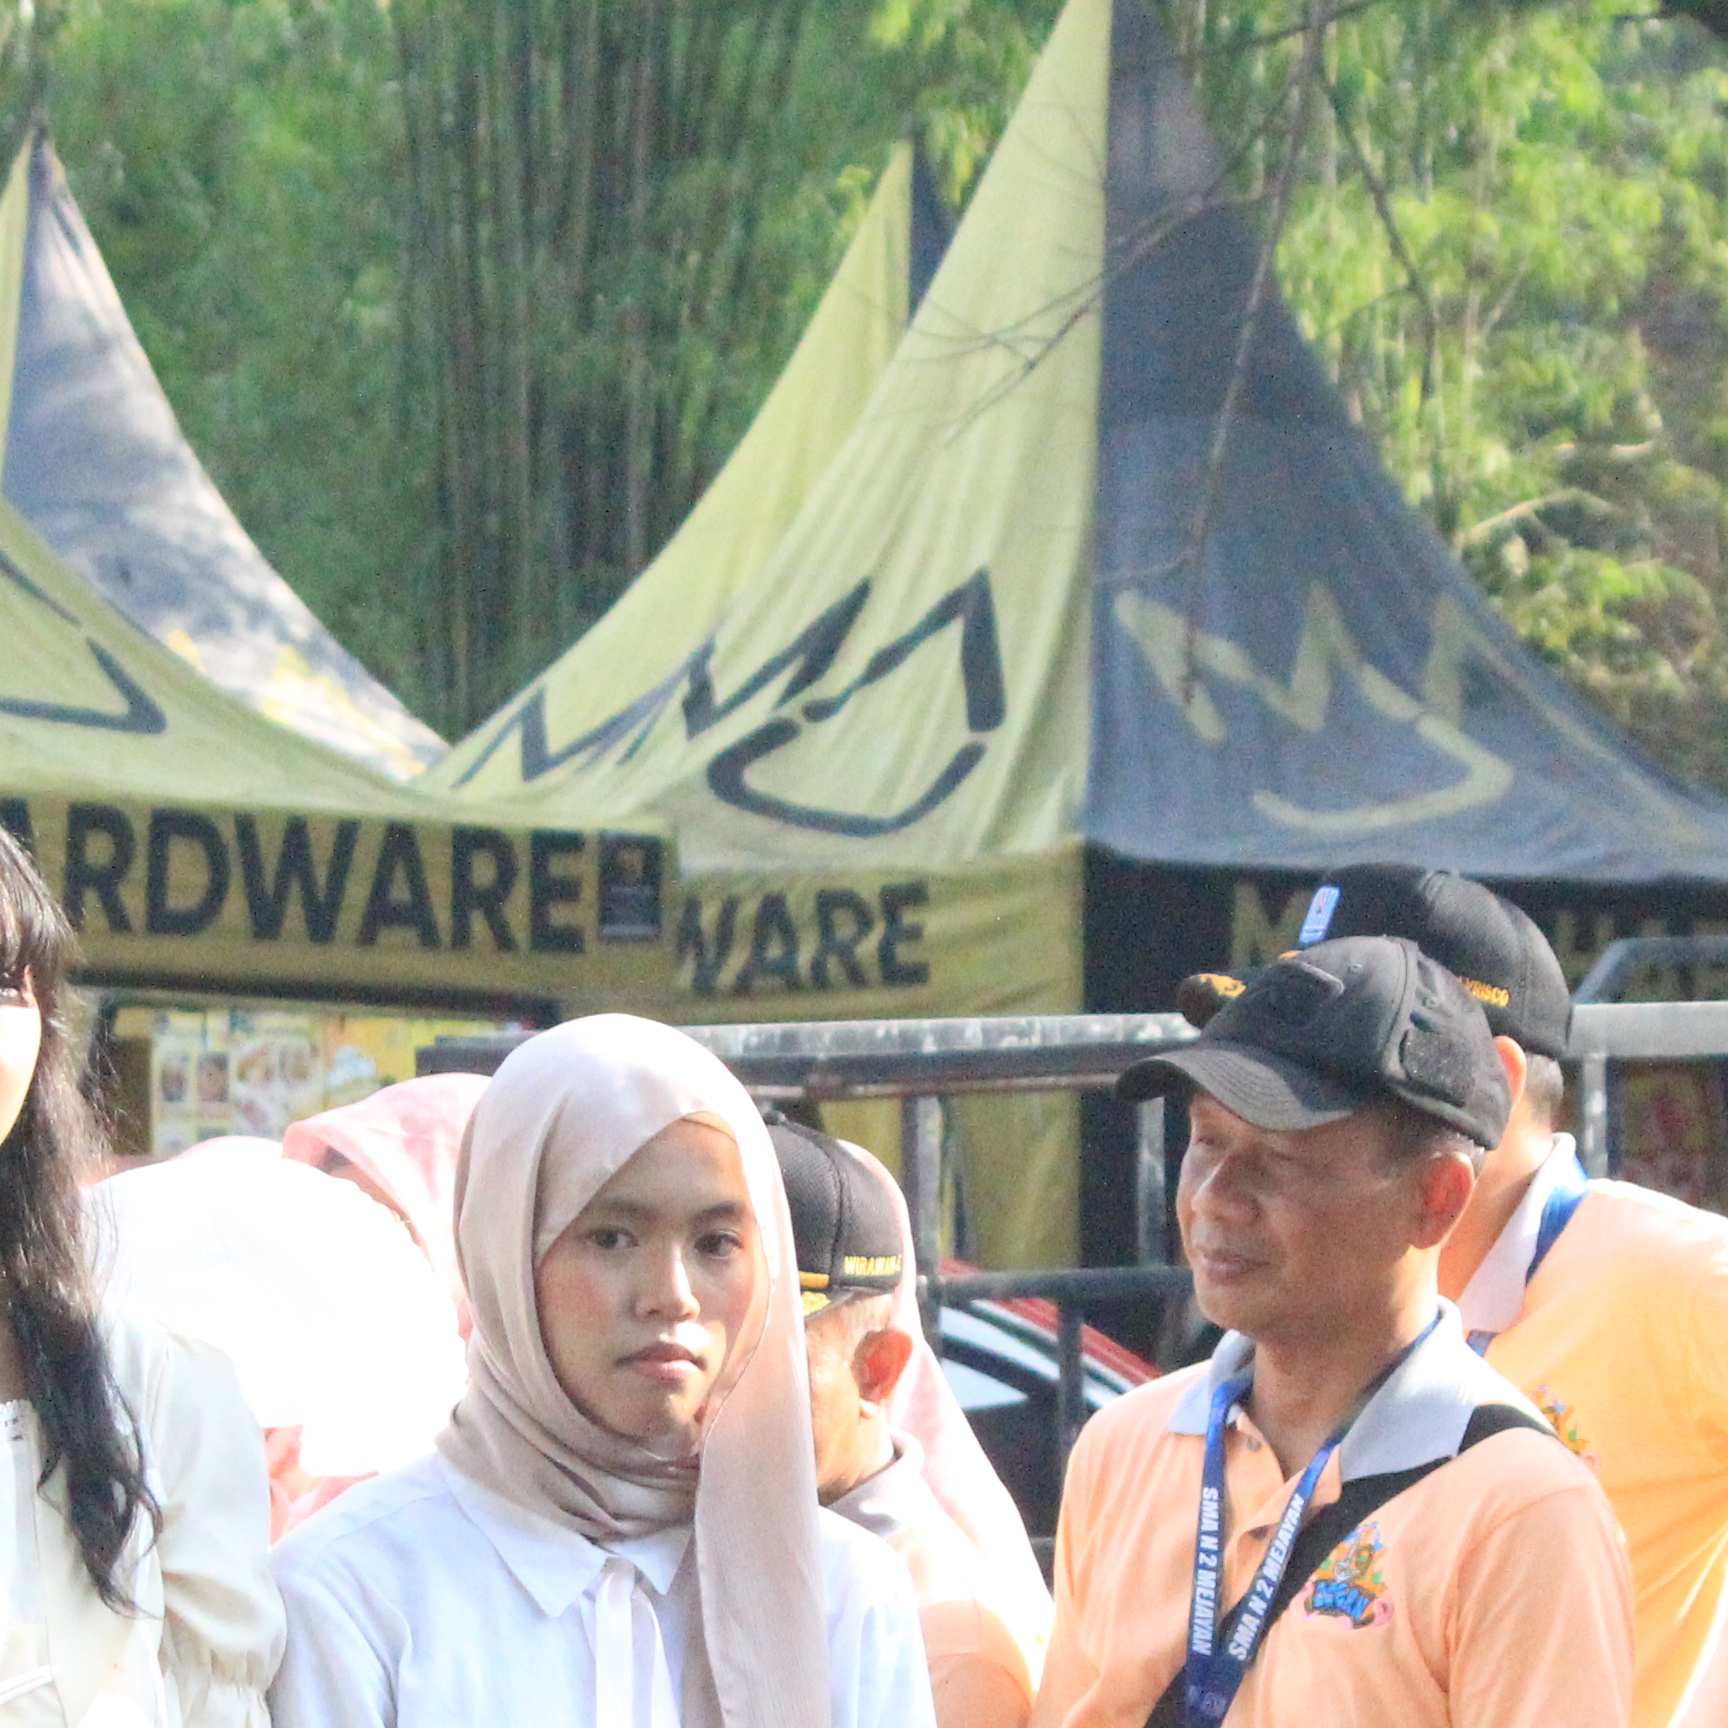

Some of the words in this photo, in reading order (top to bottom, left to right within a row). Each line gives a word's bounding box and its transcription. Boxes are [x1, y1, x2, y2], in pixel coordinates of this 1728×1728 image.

[676, 880, 930, 997] WARE
[1200, 1486, 1219, 1531] SMA
[1199, 1535, 1219, 1550] N
[1262, 1493, 1305, 1582] MEJAYAN
[1199, 1553, 1218, 1568] 2
[1248, 1594, 1268, 1616] N
[1256, 1578, 1274, 1599] 2
[1191, 1569, 1217, 1656] MEJAYAN
[1228, 1613, 1261, 1661] SMA
